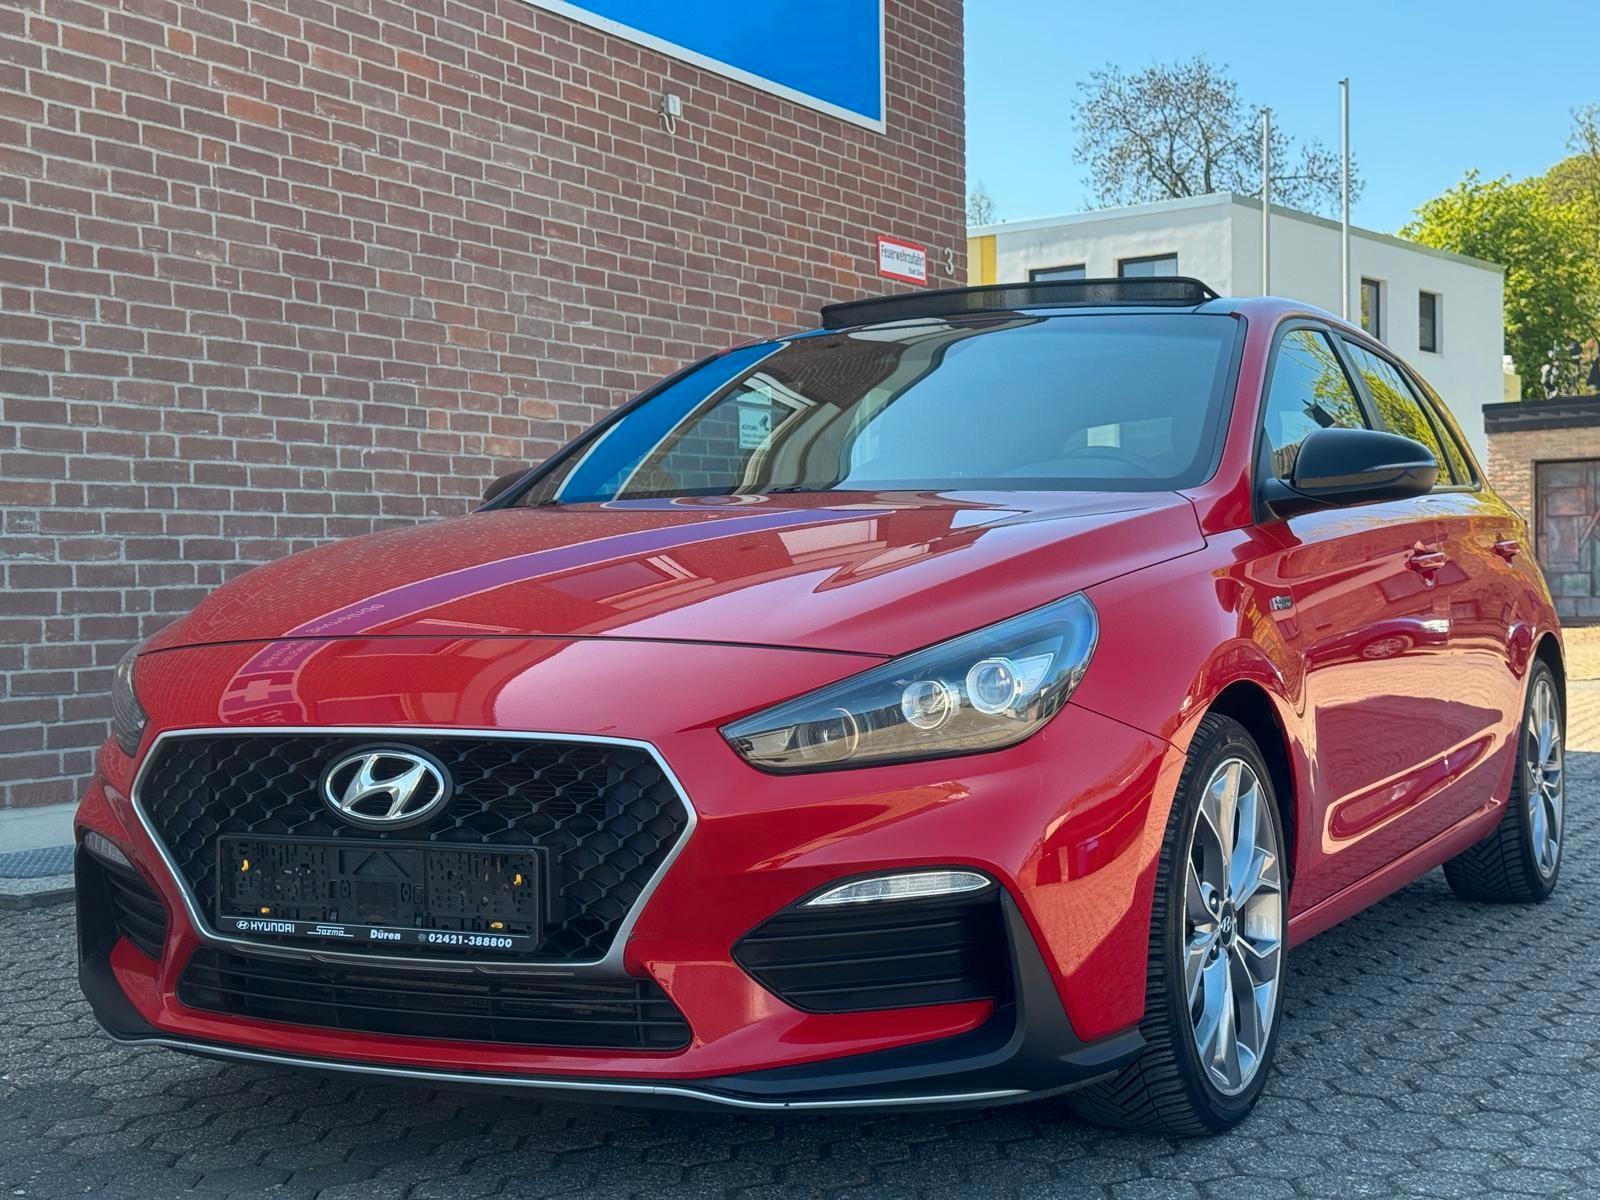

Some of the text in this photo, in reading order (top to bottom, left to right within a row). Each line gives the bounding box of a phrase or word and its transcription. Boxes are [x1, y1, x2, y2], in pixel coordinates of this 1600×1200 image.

[944, 246, 954, 275] 3
[250, 921, 295, 933] HYUNDAI
[370, 928, 401, 940] Düren
[428, 933, 513, 948] 02421-388800
